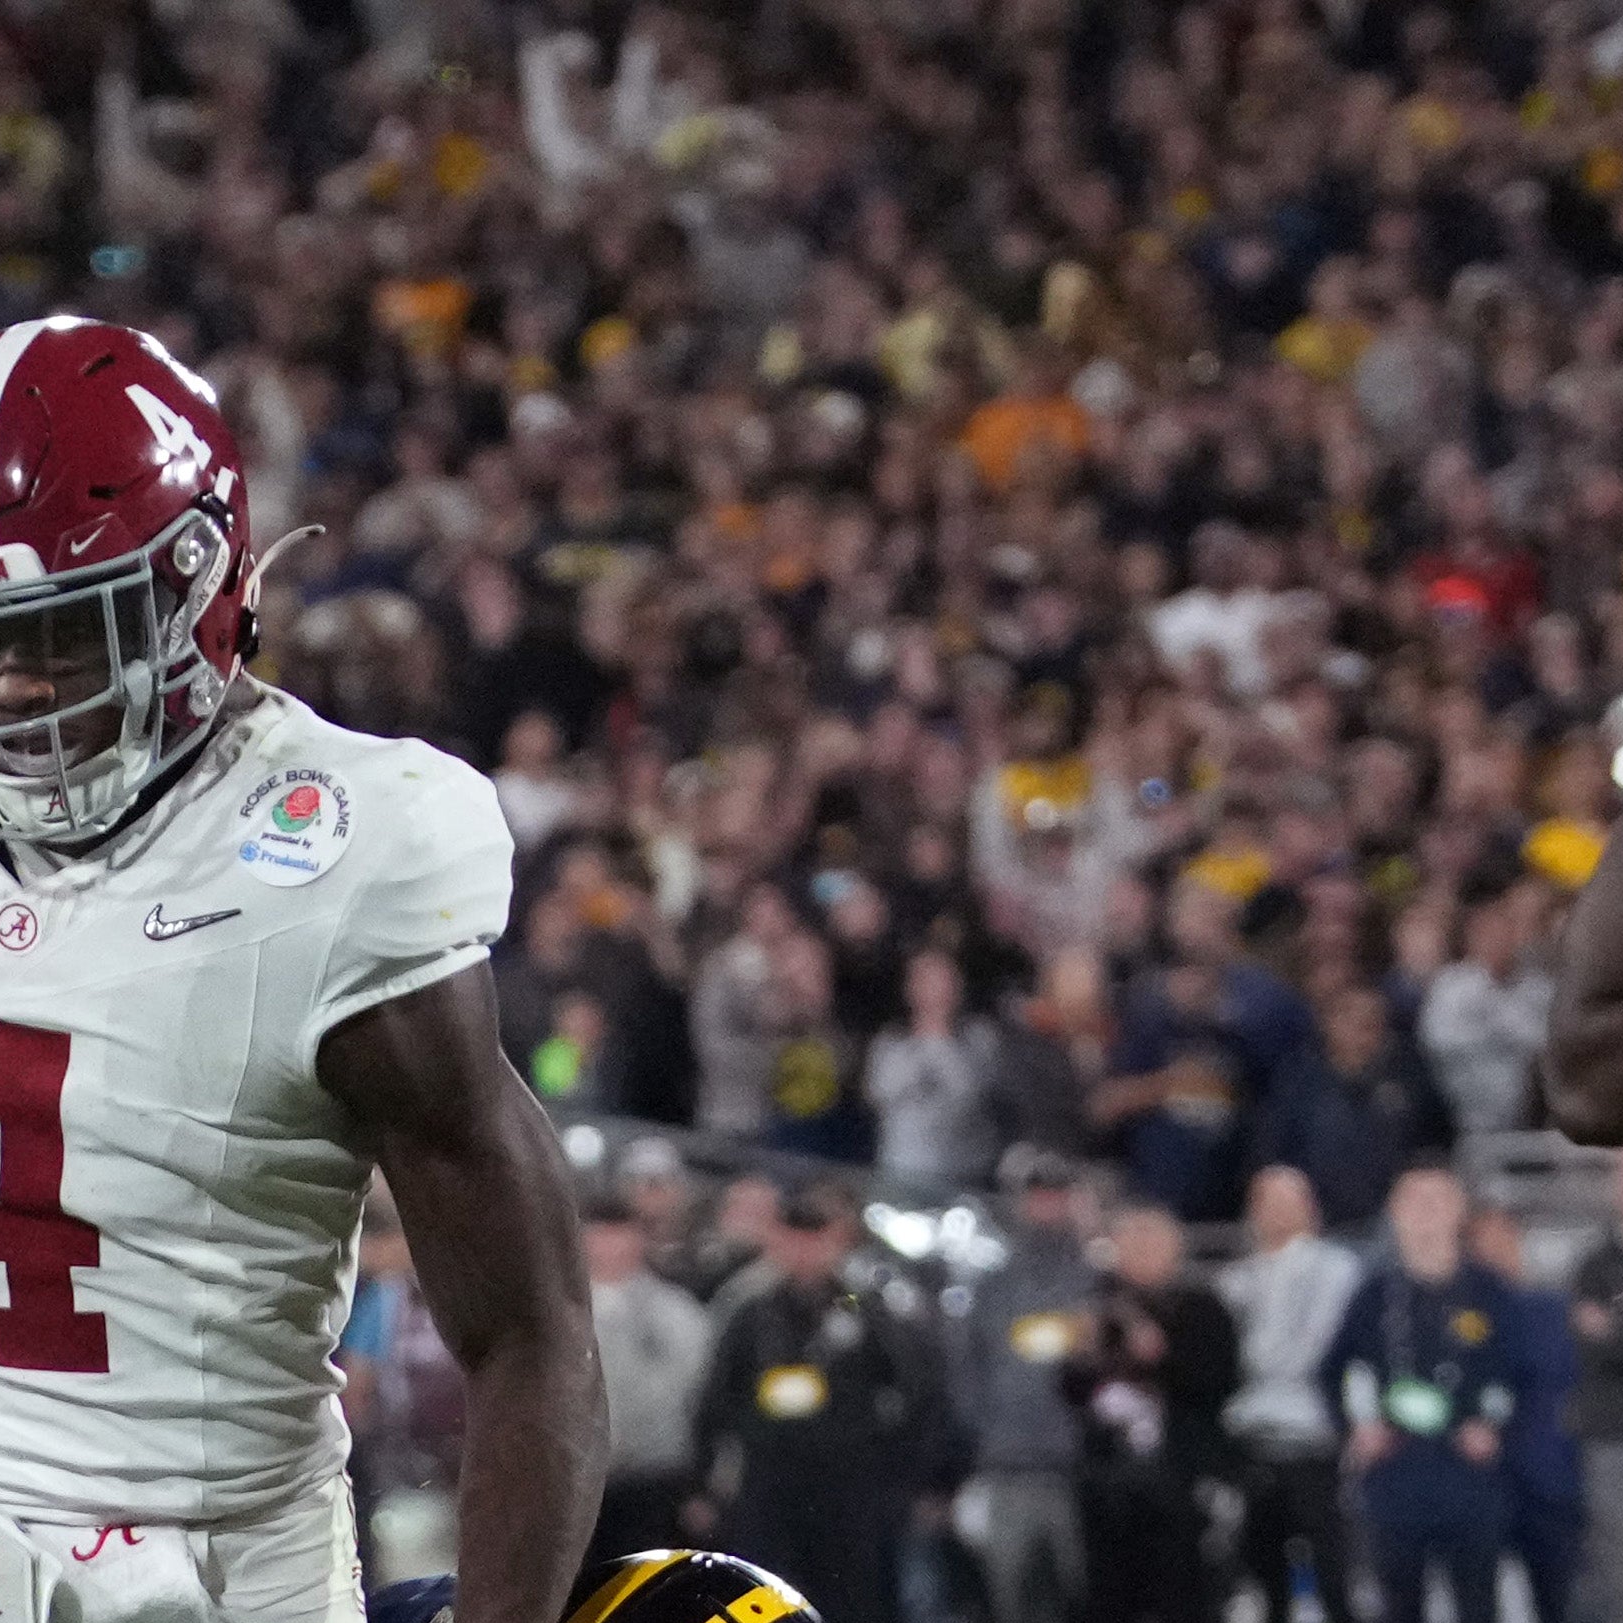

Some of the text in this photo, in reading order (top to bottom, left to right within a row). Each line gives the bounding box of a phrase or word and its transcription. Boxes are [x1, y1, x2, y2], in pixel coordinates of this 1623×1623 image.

[124, 383, 213, 473] 4
[240, 769, 350, 838] ROSE BOWL GAME
[0, 911, 30, 941] A
